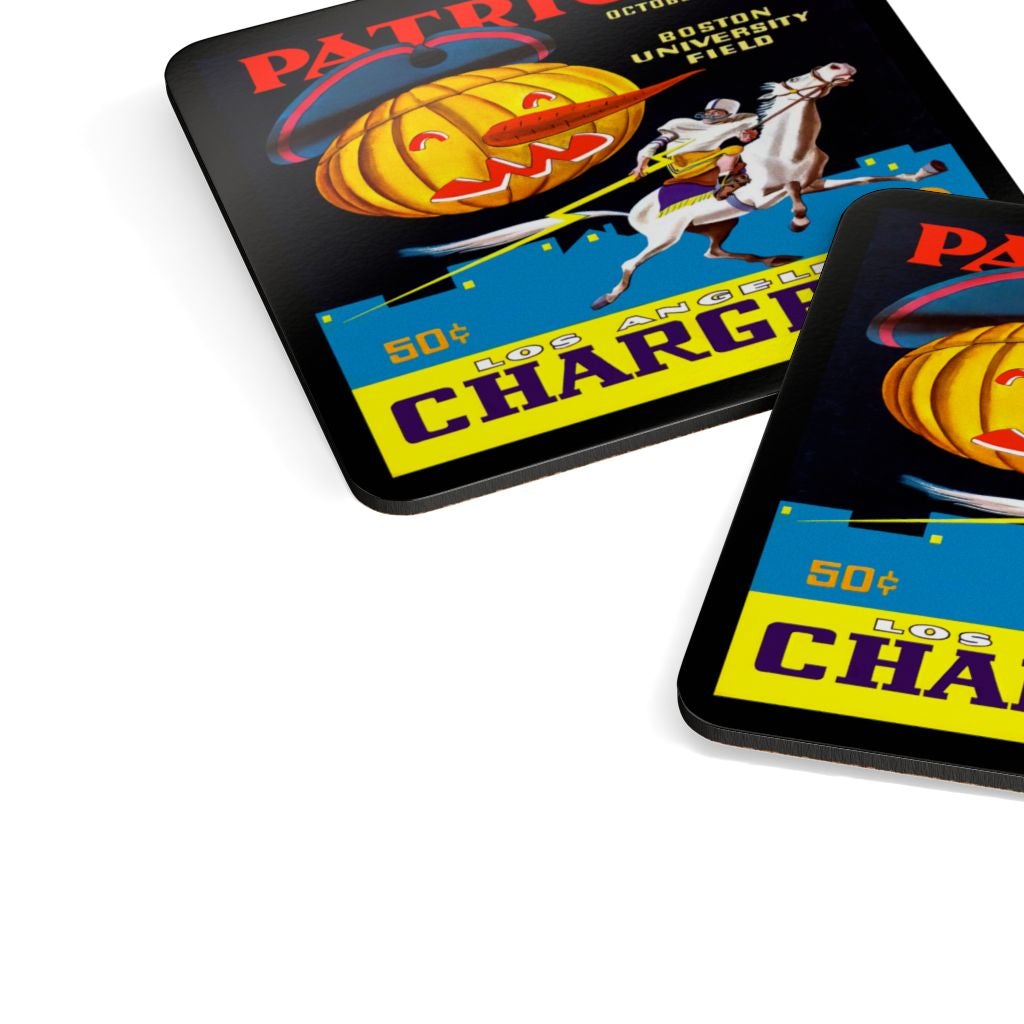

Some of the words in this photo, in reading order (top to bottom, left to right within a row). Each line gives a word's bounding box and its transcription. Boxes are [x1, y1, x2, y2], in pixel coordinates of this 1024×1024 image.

[631, 11, 808, 64] UNIVERSITY
[658, 7, 772, 43] BOSTON
[686, 34, 774, 64] FIELD
[474, 333, 582, 372] LOS
[617, 262, 825, 332] ANGEL
[384, 323, 469, 364] 50¢
[390, 279, 819, 444] CHARGE
[806, 559, 899, 596] 50¢
[874, 617, 993, 648] LOS
